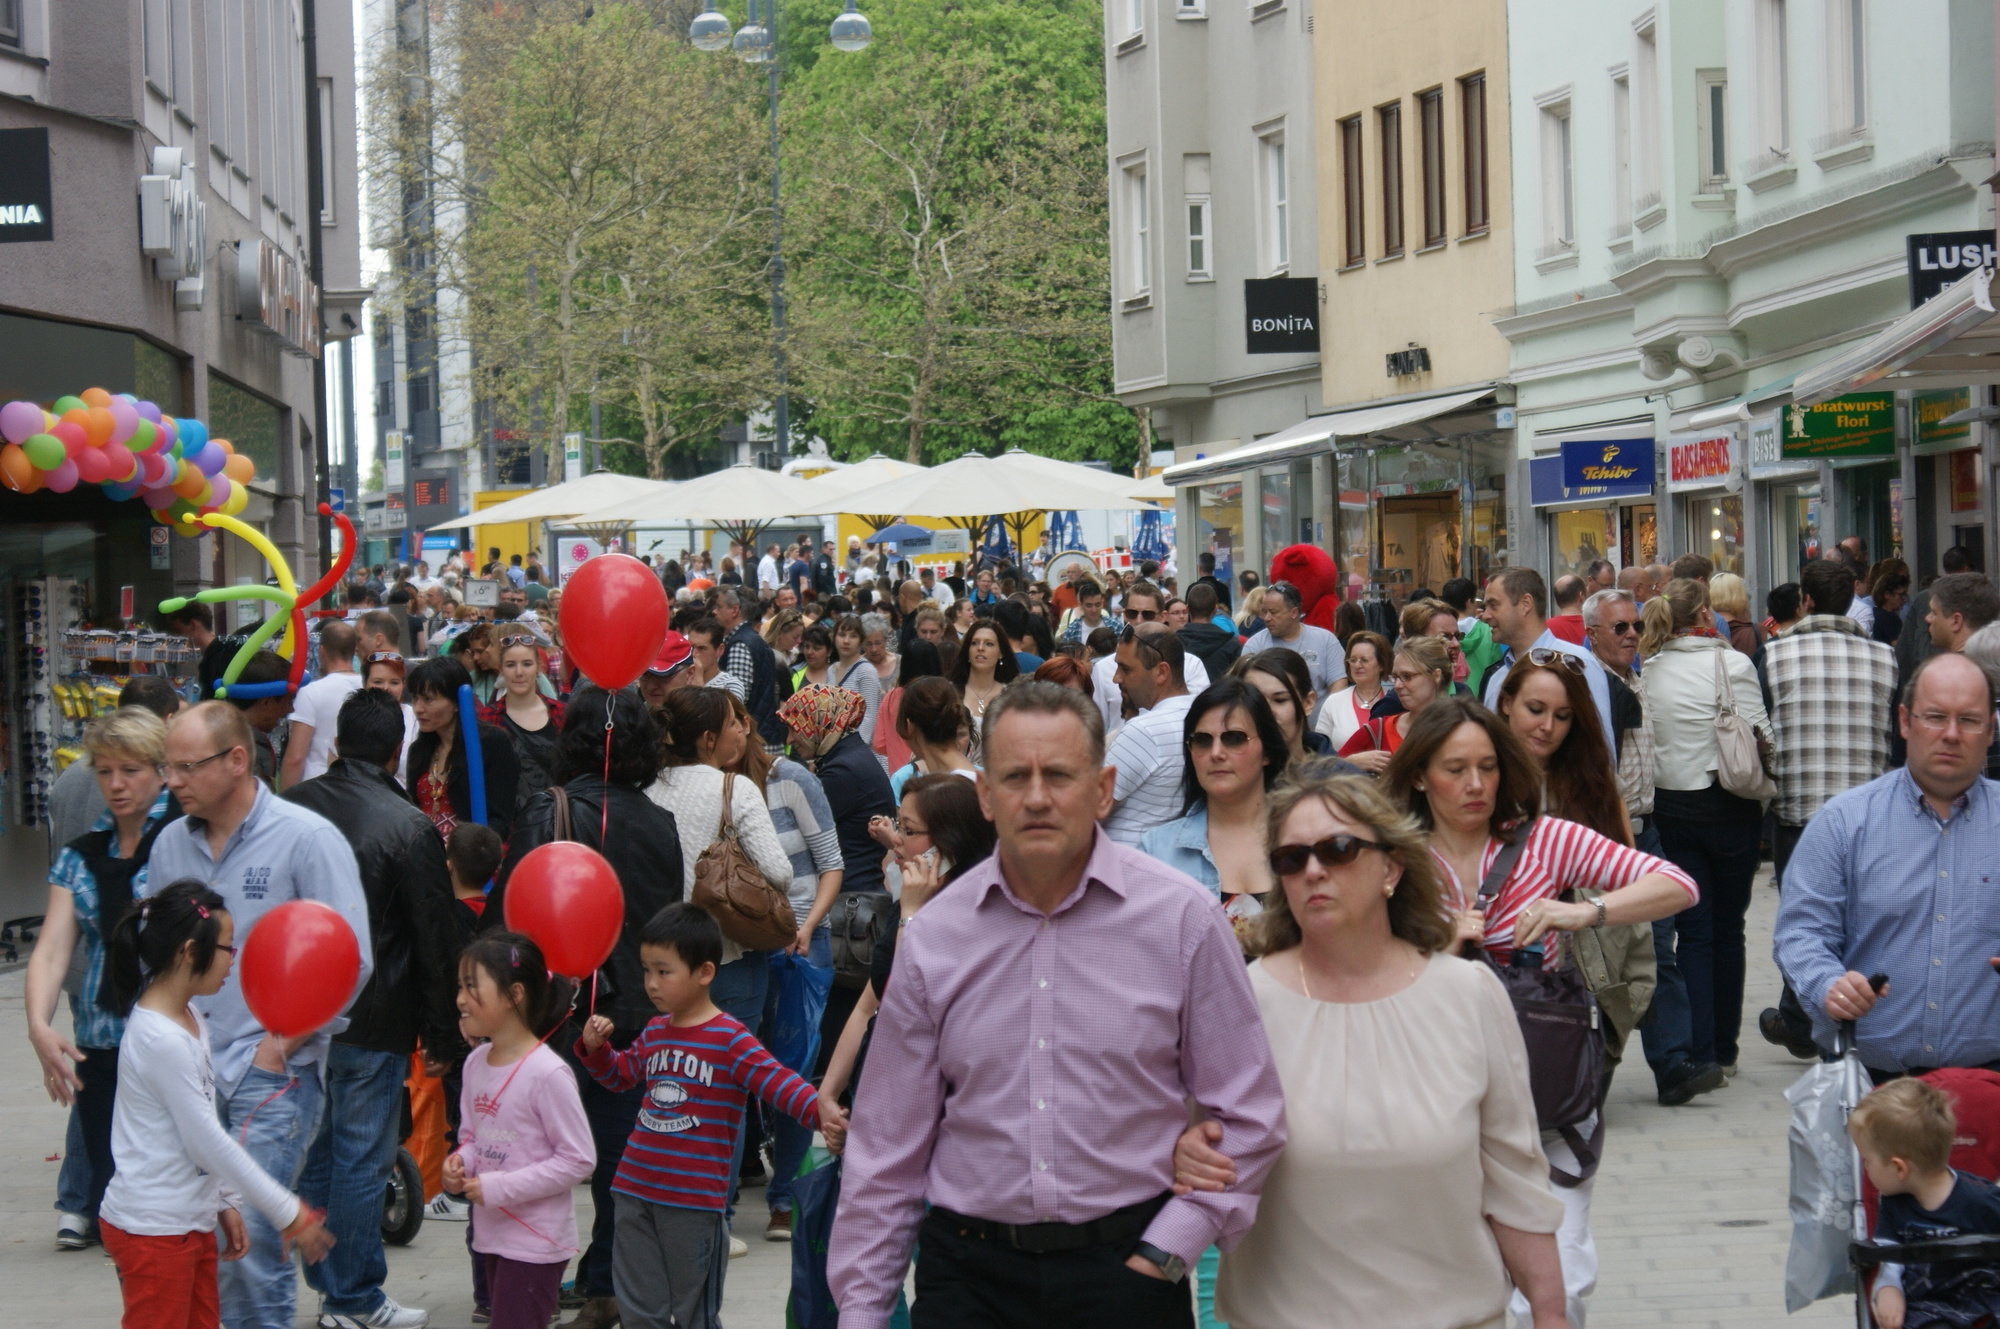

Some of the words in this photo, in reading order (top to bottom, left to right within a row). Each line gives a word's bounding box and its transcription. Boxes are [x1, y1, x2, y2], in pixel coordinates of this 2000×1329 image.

[1836, 414, 1870, 428] Flori
[1582, 465, 1638, 480] Tchibo
[646, 1049, 714, 1088] FOXTON
[664, 1118, 691, 1131] TEAM
[484, 1145, 510, 1165] day
